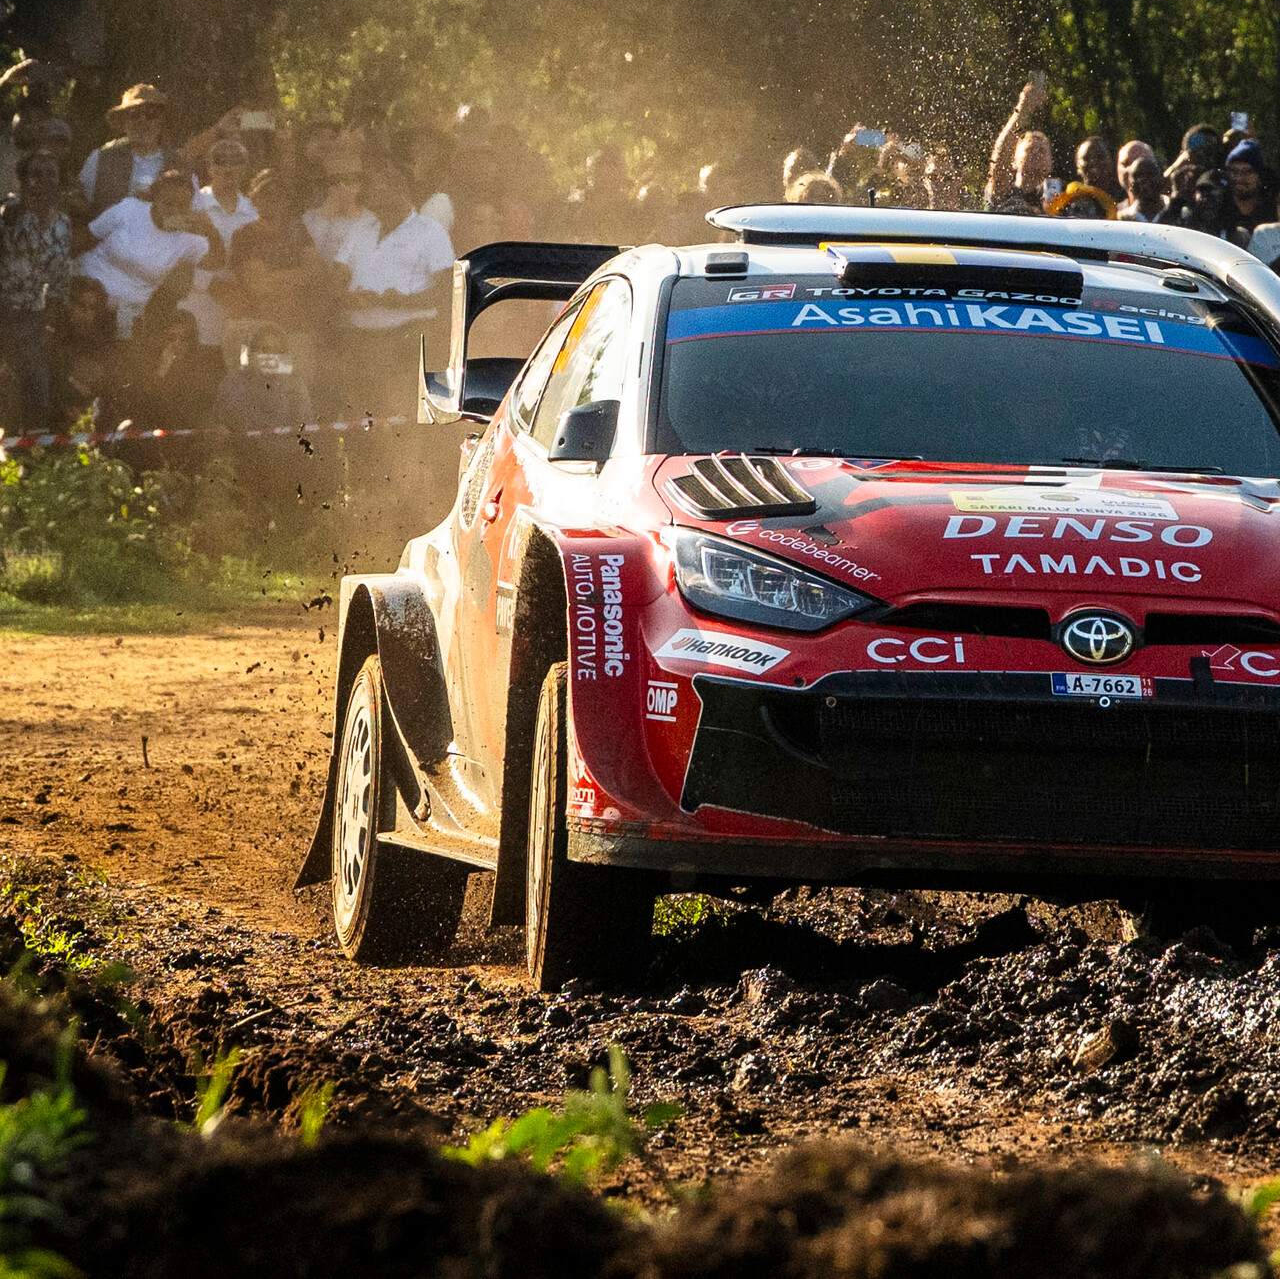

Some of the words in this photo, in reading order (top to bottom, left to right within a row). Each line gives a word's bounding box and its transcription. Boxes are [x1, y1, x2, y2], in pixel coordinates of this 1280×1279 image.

[730, 287, 792, 301] GR
[806, 287, 947, 297] TOYOTA
[957, 288, 1083, 306] GAZOO
[1075, 507, 1124, 515] KENYA
[1127, 509, 1167, 518] 2026
[942, 515, 1214, 548] DENSO
[758, 527, 876, 583] codebeamer
[970, 553, 1203, 583] TAMADIC
[598, 554, 631, 677] Panasonic
[1072, 676, 1136, 694] A-7662
[1142, 678, 1151, 686] 11
[1142, 687, 1153, 697] 26
[647, 687, 678, 715] OMP
